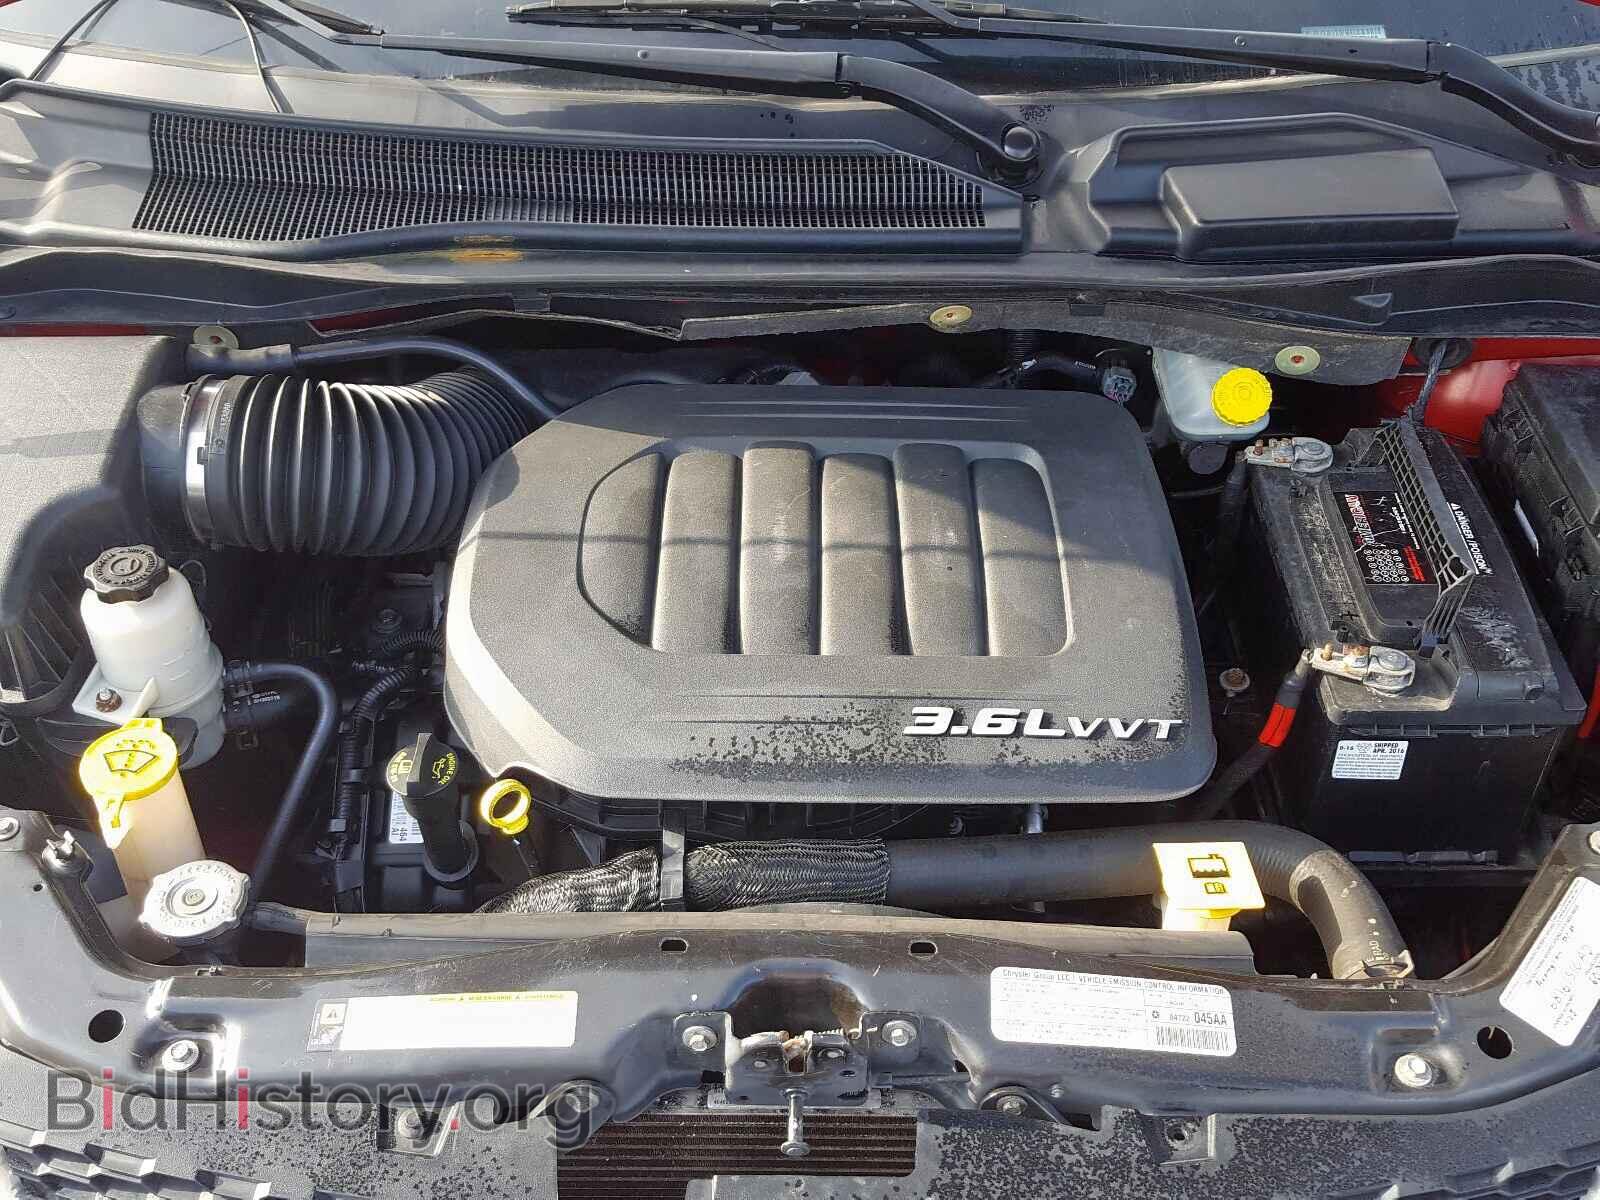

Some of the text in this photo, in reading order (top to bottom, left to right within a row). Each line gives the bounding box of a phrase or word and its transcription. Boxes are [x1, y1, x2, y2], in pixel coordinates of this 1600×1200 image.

[1003, 968, 1224, 995] Chrysler Group LLC VEHICLE EMISSION CONTROL INFORMATION
